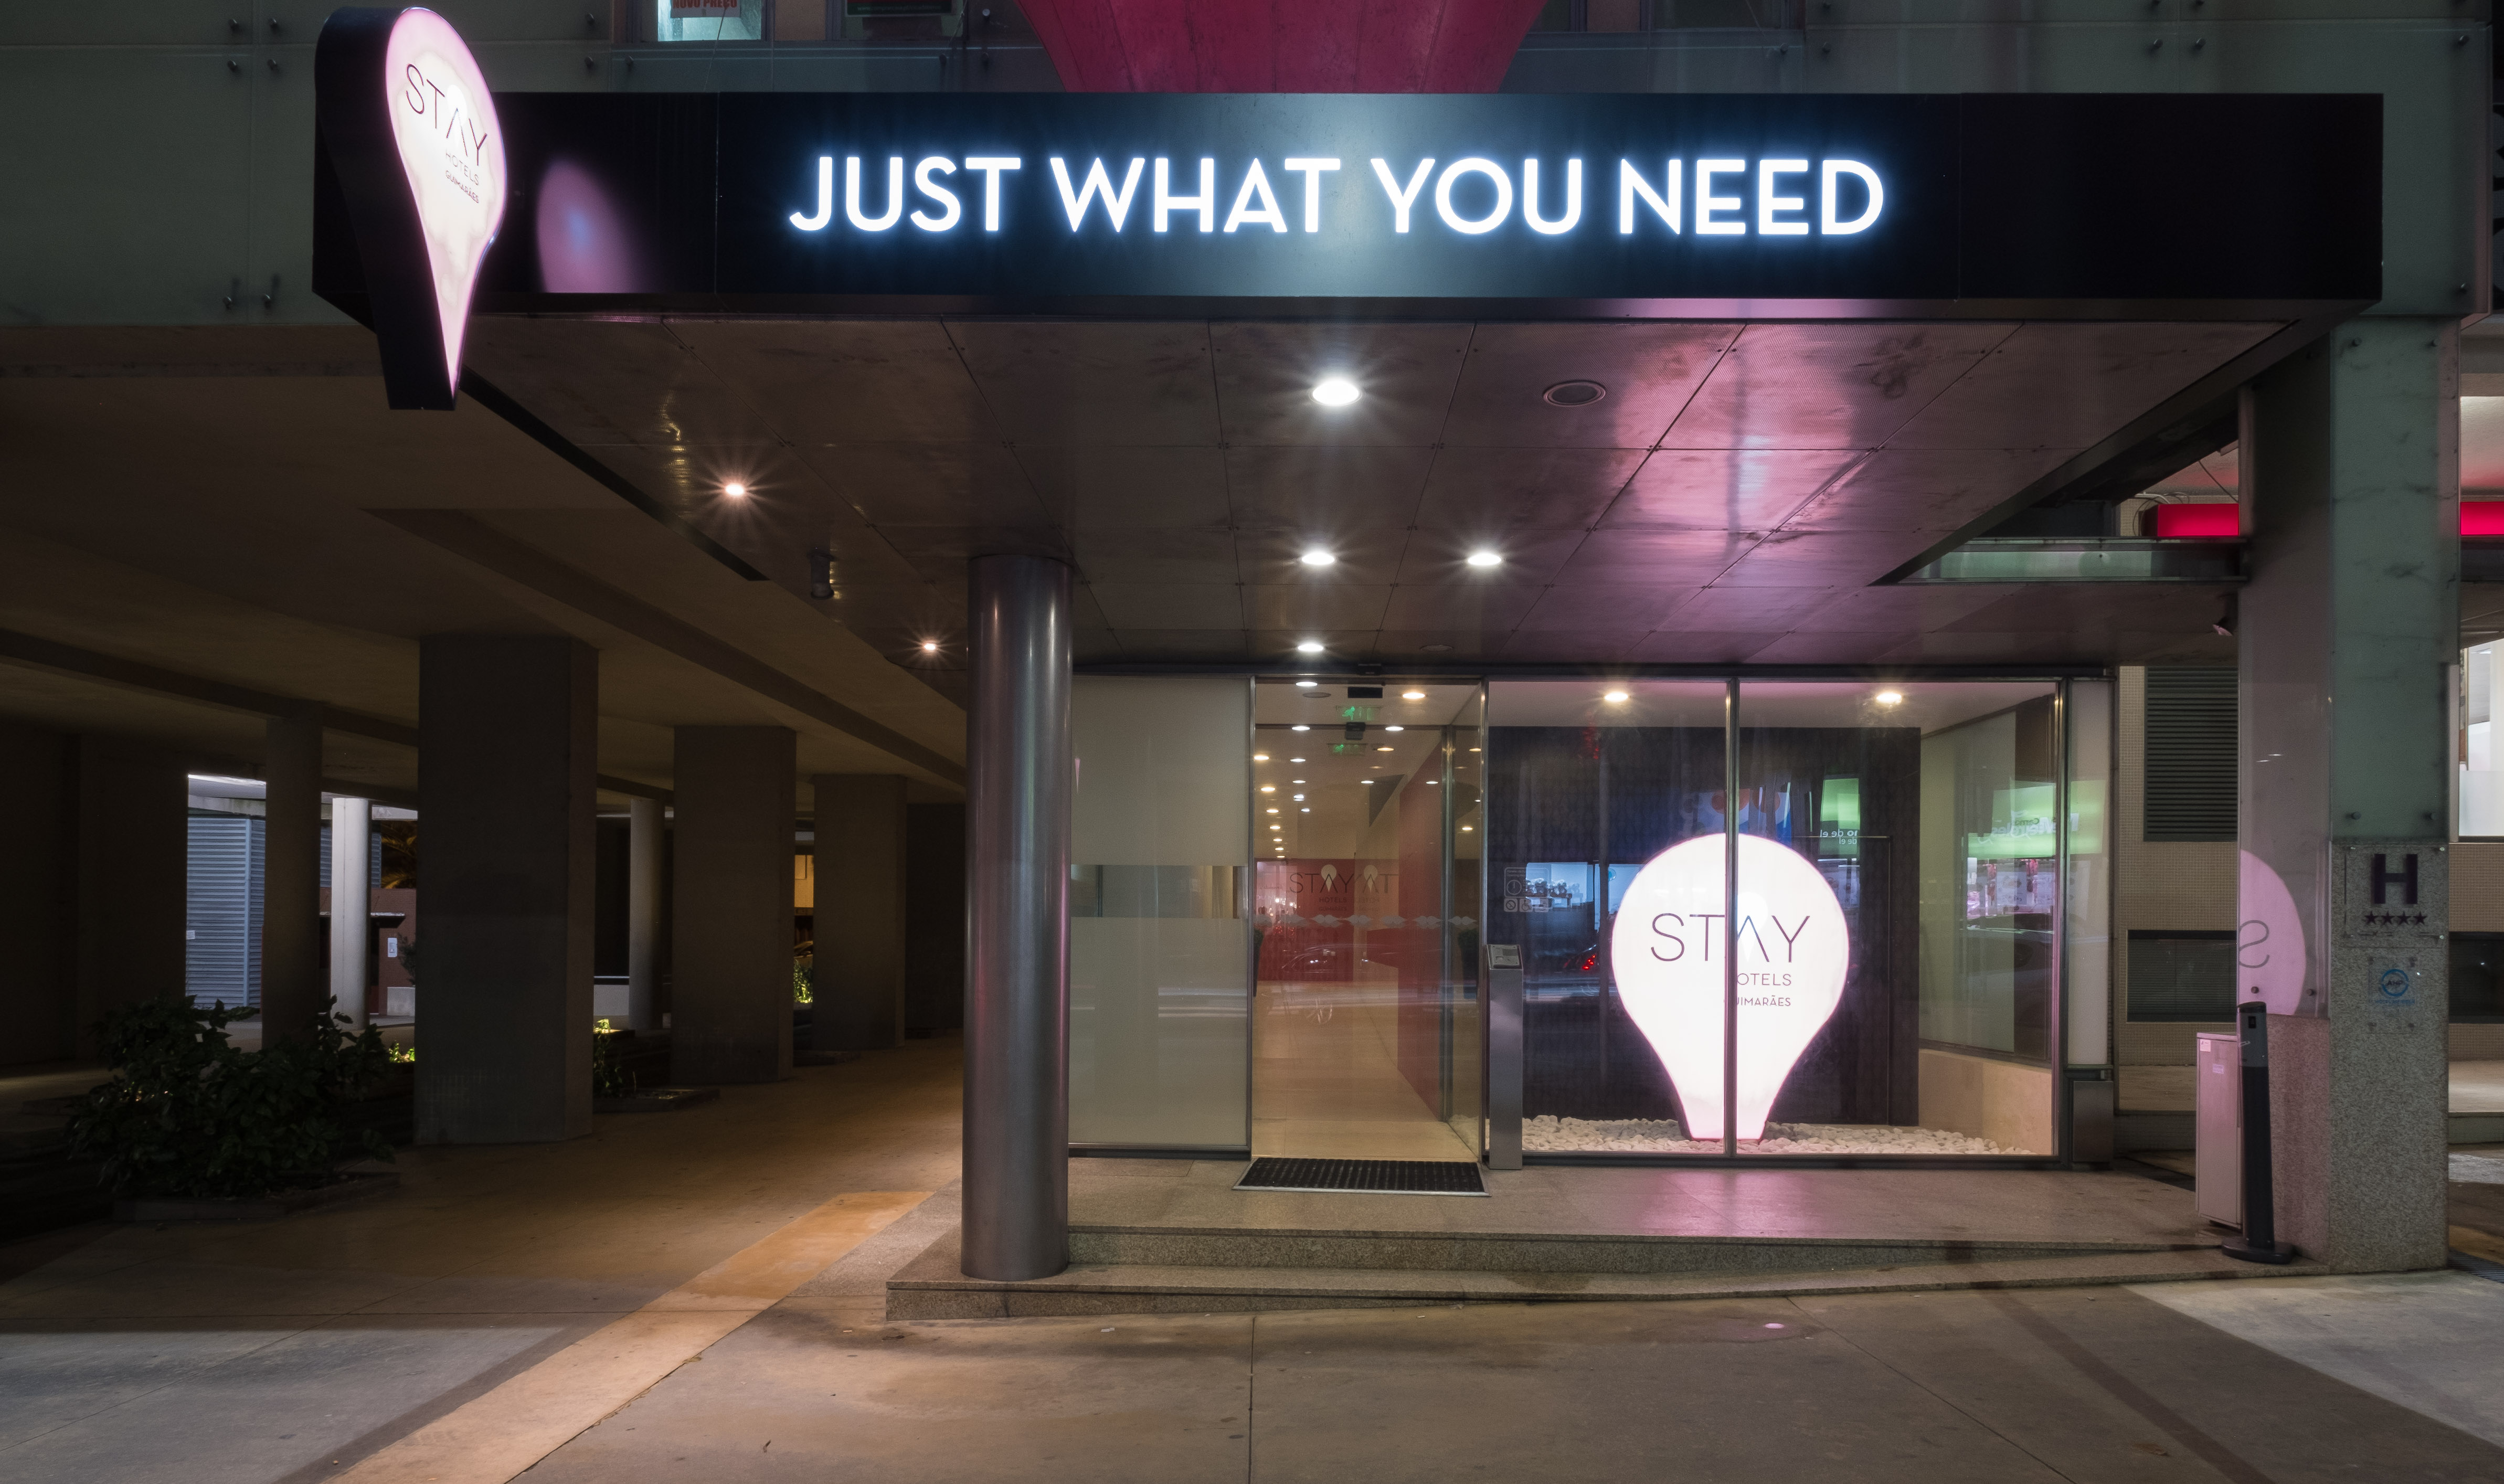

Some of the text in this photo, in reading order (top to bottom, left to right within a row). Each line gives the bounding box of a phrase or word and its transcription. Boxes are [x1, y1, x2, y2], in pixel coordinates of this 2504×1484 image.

[406, 63, 487, 166] STAY
[446, 149, 479, 186] HOTELS
[789, 156, 1883, 235] JUST WHAT YOU NEED
[1289, 873, 1354, 894] STAY
[2374, 853, 2418, 904] H
[1651, 913, 1810, 962] STAY
[1736, 973, 1791, 986] OTELS
